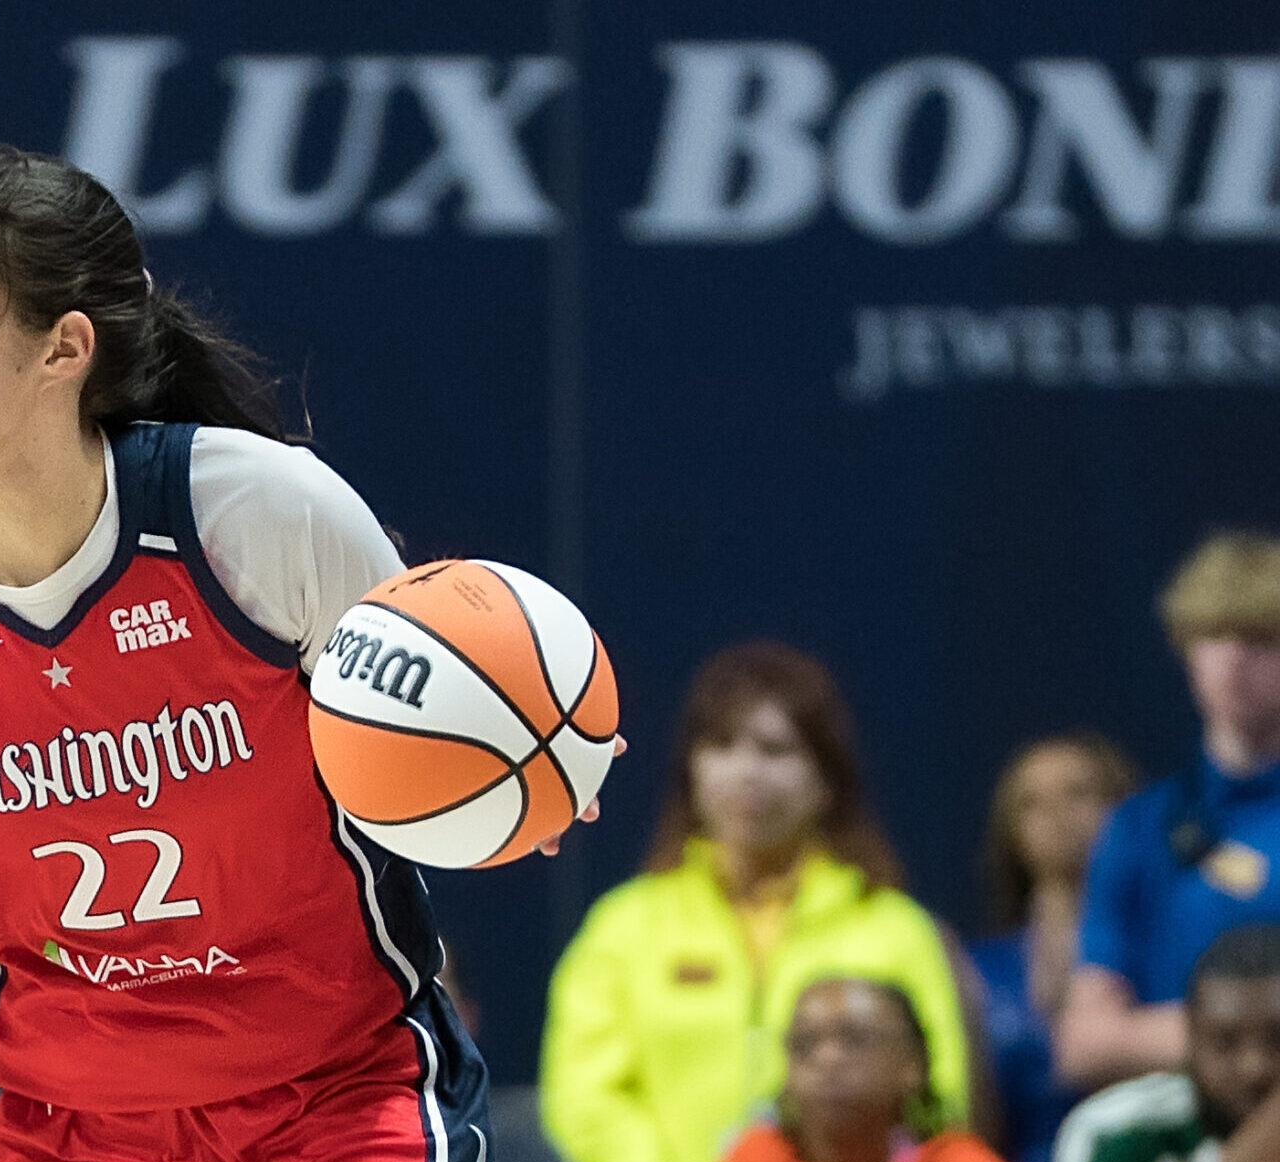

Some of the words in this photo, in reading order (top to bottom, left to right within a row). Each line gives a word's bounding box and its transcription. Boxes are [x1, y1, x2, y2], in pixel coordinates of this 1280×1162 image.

[62, 34, 574, 238] LUX
[109, 599, 172, 631] CAR
[116, 616, 192, 654] max
[321, 626, 432, 710] Wilso
[30, 828, 202, 931] 22
